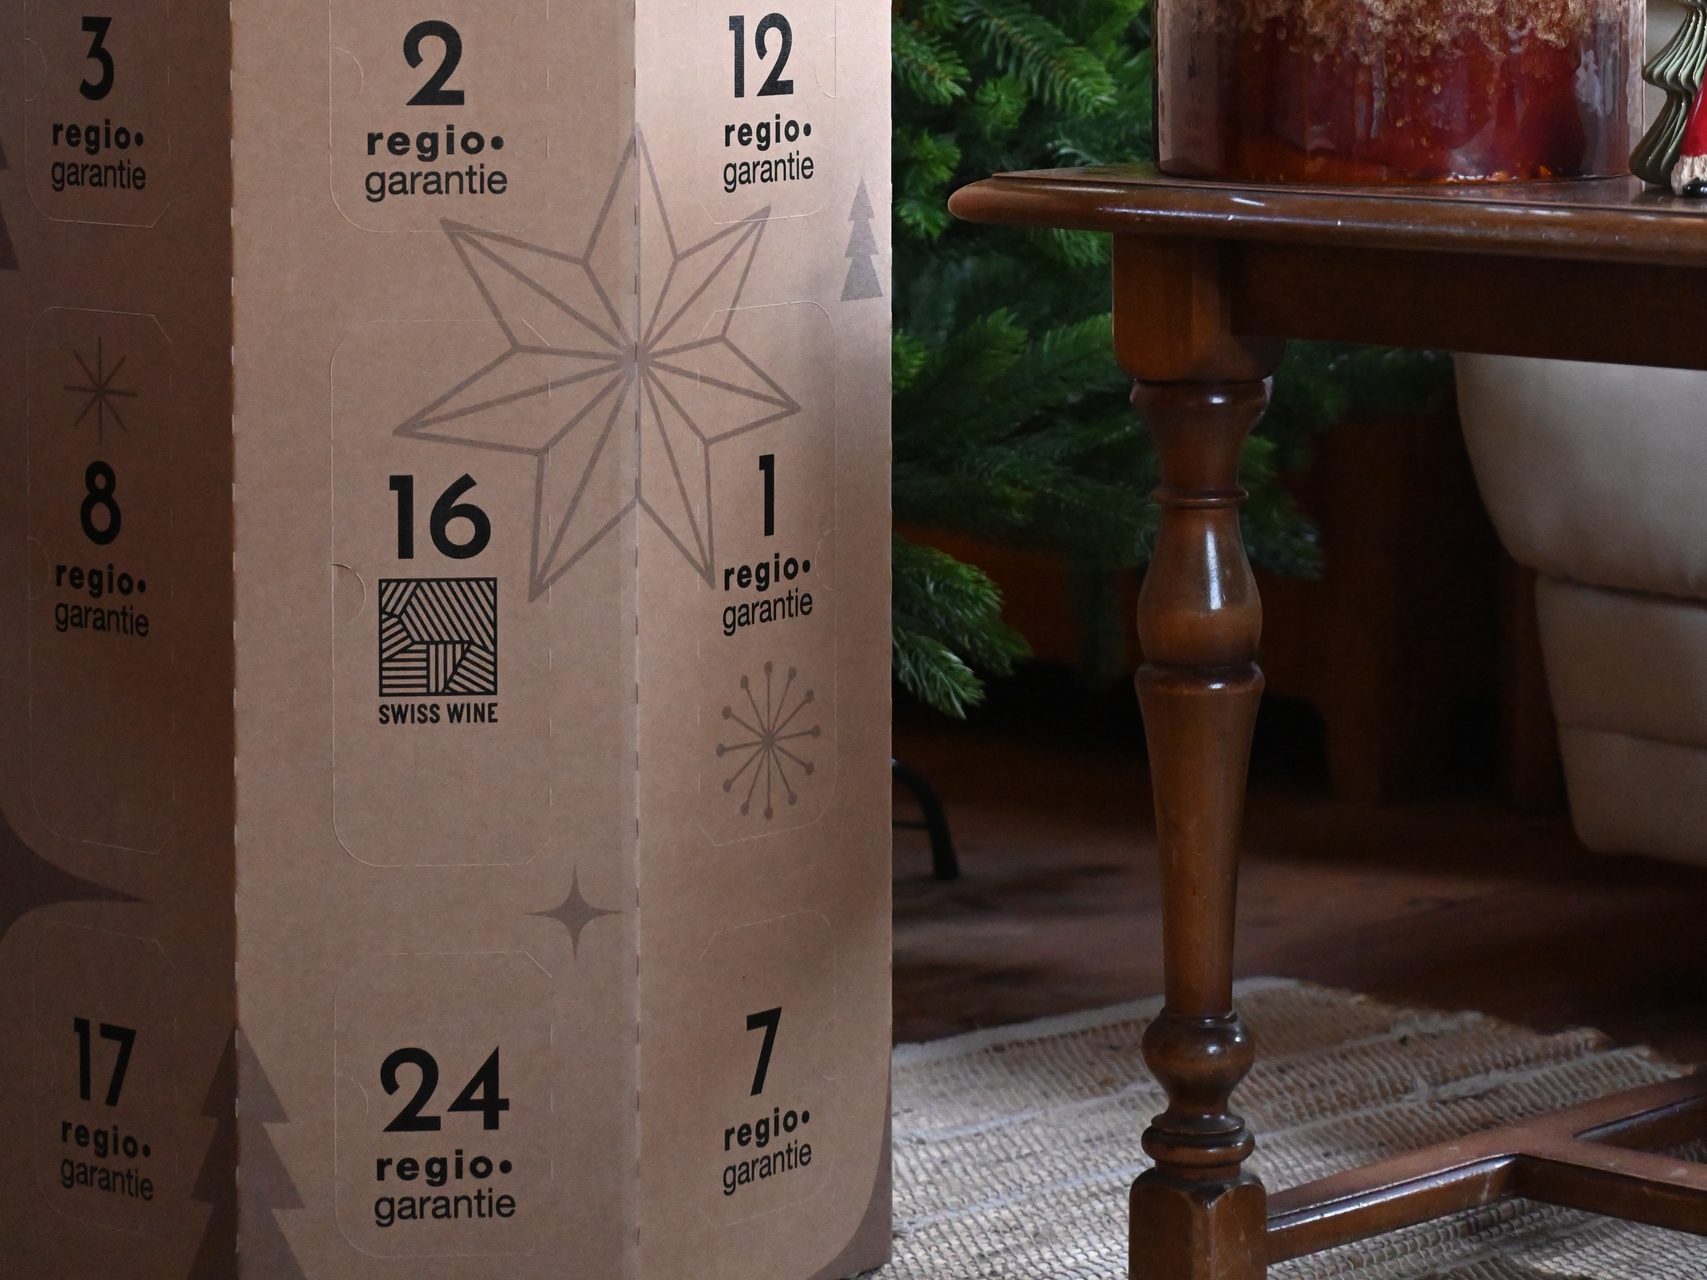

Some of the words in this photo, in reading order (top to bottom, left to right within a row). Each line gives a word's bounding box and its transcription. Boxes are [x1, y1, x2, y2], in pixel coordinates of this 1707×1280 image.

[79, 16, 115, 101] 3
[402, 19, 465, 106] 2
[728, 12, 794, 99] 12
[51, 159, 147, 193] garantie
[364, 163, 508, 203] garantie
[723, 152, 814, 194] garantie
[79, 460, 122, 546] 8
[389, 473, 492, 560] 16
[758, 453, 775, 537] 1
[54, 602, 150, 638] garantie
[722, 589, 813, 637] garantie
[378, 703, 441, 725] SWISS
[446, 702, 498, 724] WINE
[73, 1016, 137, 1107] 17
[746, 1006, 783, 1097] 7
[379, 1046, 510, 1133] 24
[60, 1158, 154, 1202] garantie
[722, 1142, 812, 1197] garantie
[374, 1187, 516, 1228] garantie
